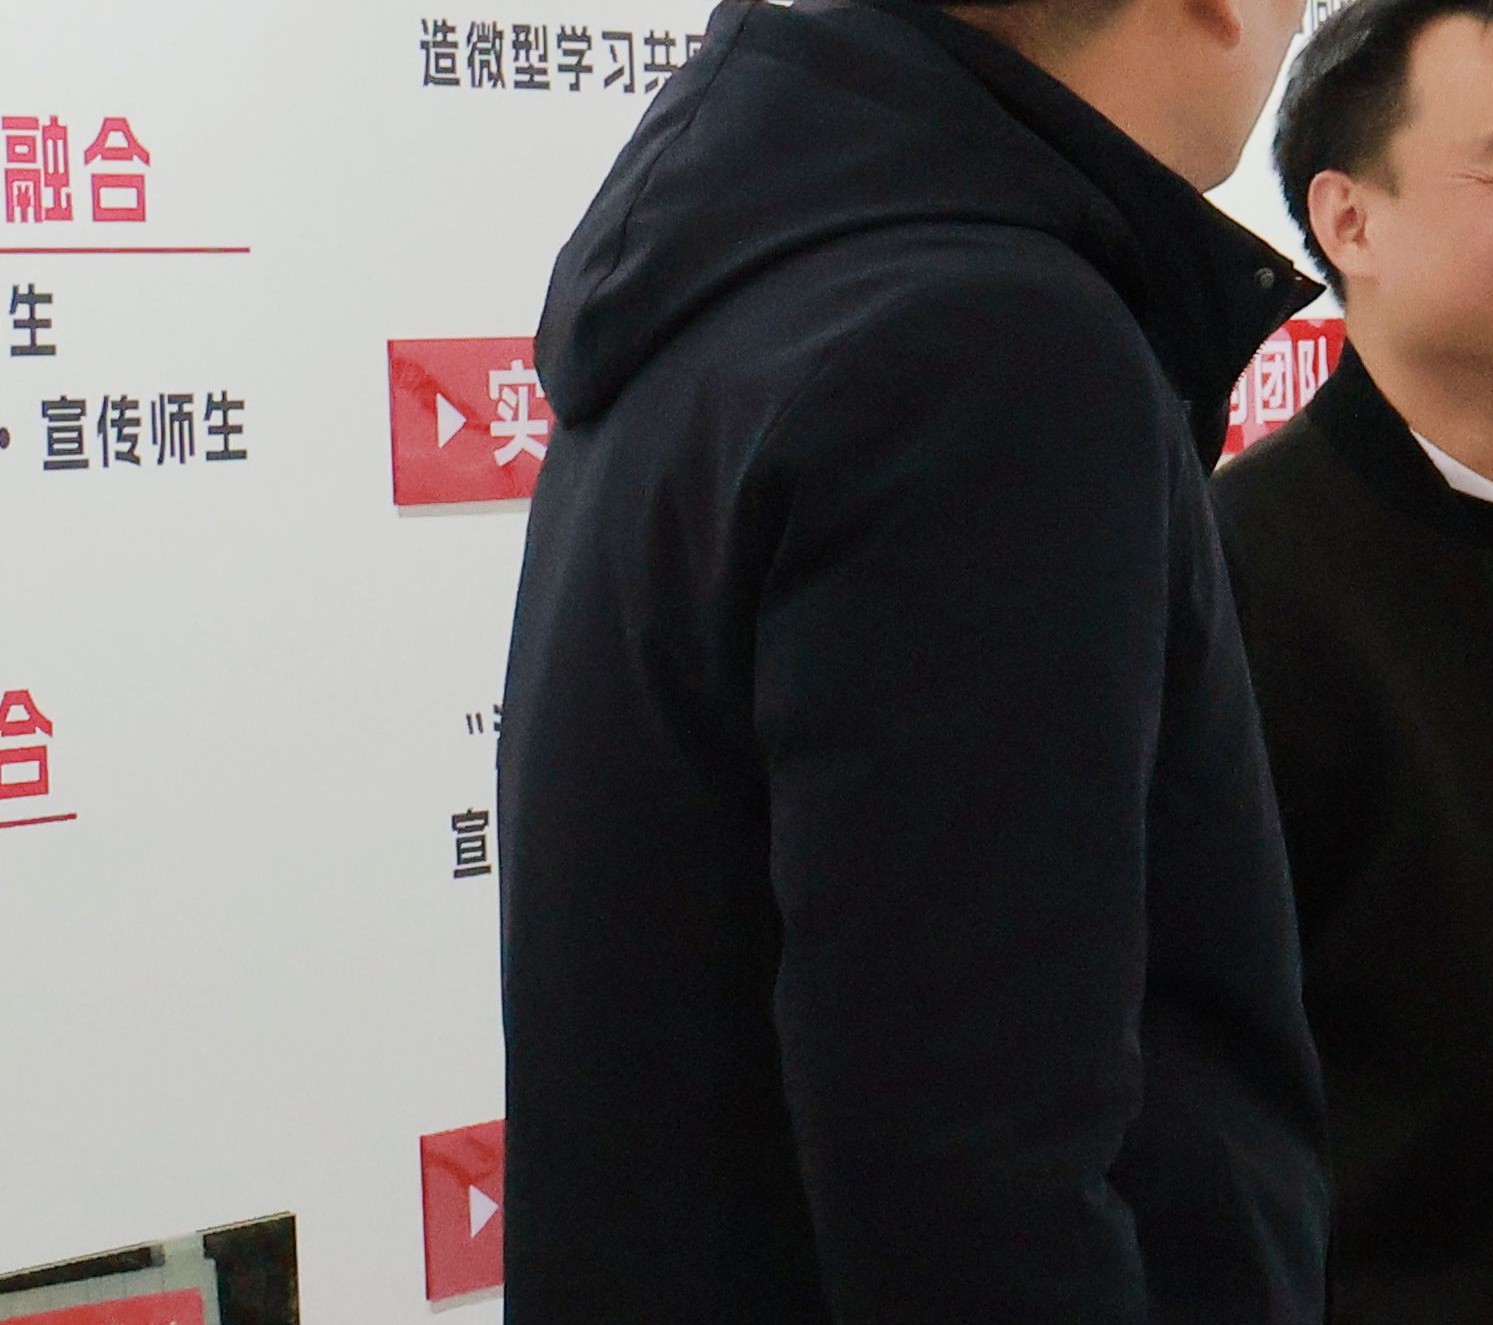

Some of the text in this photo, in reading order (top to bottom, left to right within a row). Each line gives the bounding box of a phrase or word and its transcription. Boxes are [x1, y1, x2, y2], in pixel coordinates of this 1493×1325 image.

[420, 18, 704, 94] 造微型学习共
[1, 115, 151, 223] 融合
[9, 283, 57, 357] 生
[41, 390, 249, 471] 宣传师生
[488, 359, 549, 467] 实
[0, 688, 53, 801] 合
[452, 807, 492, 879] 宣
